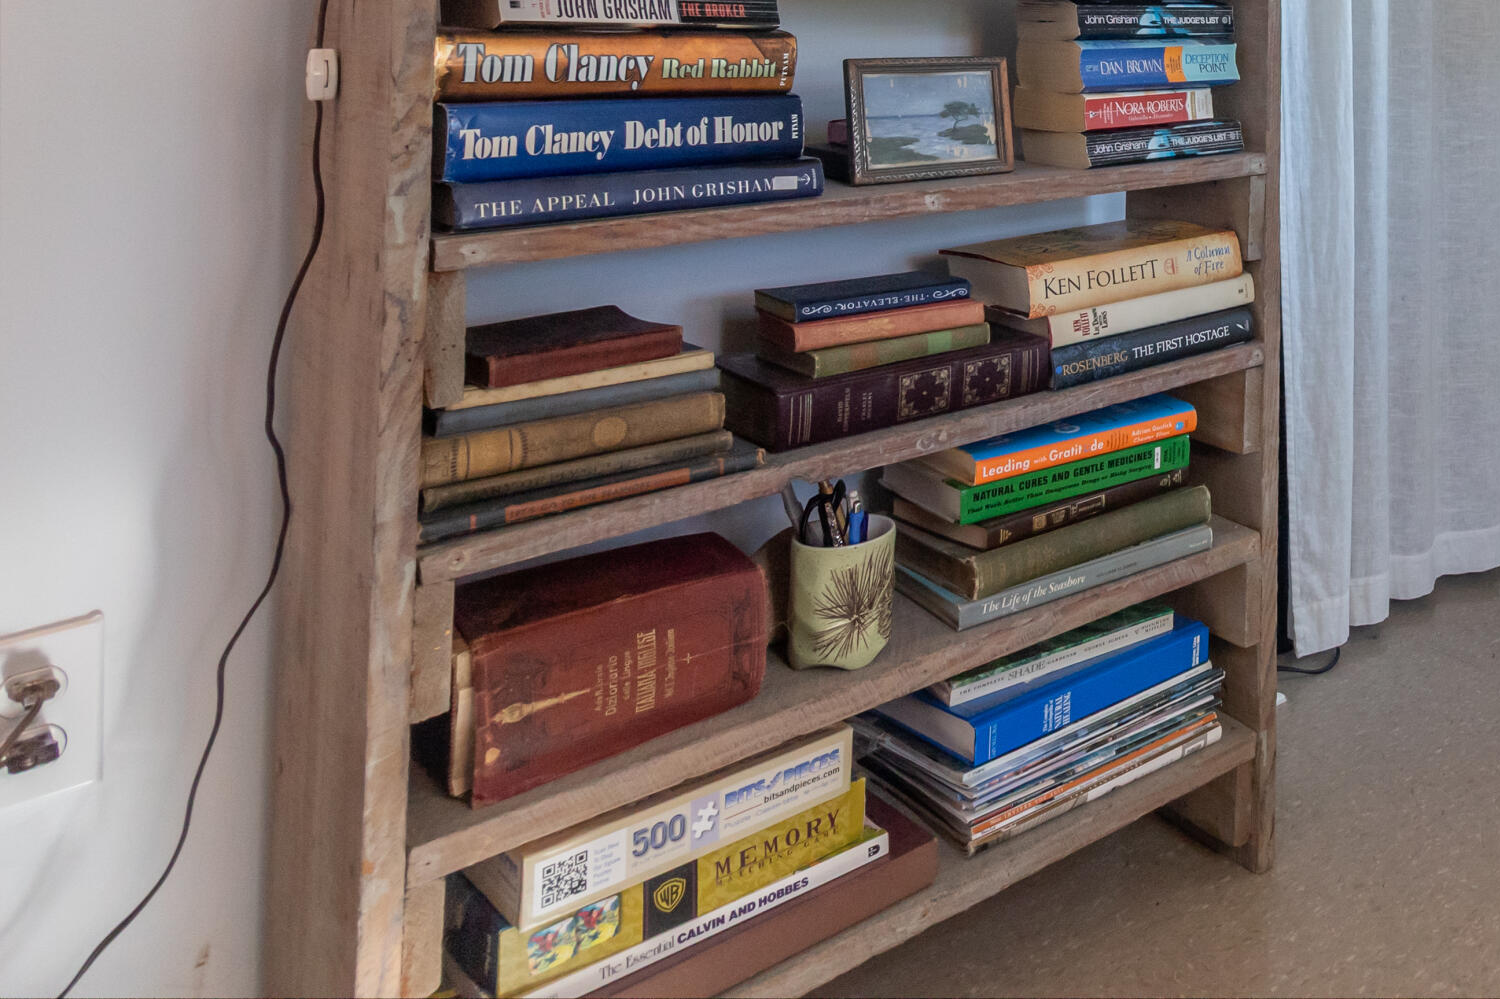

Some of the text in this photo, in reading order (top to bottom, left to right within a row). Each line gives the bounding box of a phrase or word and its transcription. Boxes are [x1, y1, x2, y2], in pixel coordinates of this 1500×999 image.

[682, 1, 746, 18] THE BROKER
[1085, 14, 1139, 25] John Grisham
[1163, 16, 1177, 24] THE
[1205, 16, 1219, 24] LIST
[457, 42, 655, 91] Tom Clancy
[662, 57, 777, 79] Red Rabbit
[780, 53, 789, 87] PUTNAM
[1100, 61, 1124, 76] DAN
[1127, 58, 1163, 75] BROWN
[1185, 53, 1229, 64] DECEPTION
[1199, 62, 1227, 73] POINT
[1116, 101, 1144, 116] NORA
[1147, 99, 1184, 113] ROBERTS
[459, 124, 614, 160] Tom Clancy
[624, 116, 784, 150] Debt of Honor
[1213, 134, 1227, 142] LIST
[1094, 141, 1147, 154] John Grisham
[632, 177, 775, 205] JOHN GRISHAM
[475, 191, 616, 219] THE APPEAL
[1186, 244, 1231, 262] A Column
[1044, 259, 1158, 299] KEN FOLLETT
[1194, 260, 1224, 277] of Fire
[840, 293, 926, 311] THE ELEVATOR
[1073, 318, 1081, 334] KEN
[1080, 312, 1090, 336] FOLLETT
[1132, 325, 1230, 359] THE FIRST HOSTAGE
[1062, 350, 1129, 376] ROSENBERG
[973, 484, 1015, 502] NATURAL
[1018, 475, 1048, 492] CURES
[1051, 470, 1070, 483] AND
[1073, 462, 1105, 478] GENTLE
[1107, 450, 1153, 469] MEDICINES
[982, 459, 1030, 479] Leading
[982, 575, 1087, 615] The Life of the Seashore
[1006, 660, 1047, 681] SHADE
[605, 655, 618, 717] Dizionario
[1054, 695, 1063, 730] NATURAL
[1062, 690, 1072, 726] HEALING
[725, 778, 767, 809] BITS
[783, 748, 840, 786] PIECES
[763, 766, 840, 804] bitsandpieces.com
[632, 813, 686, 858] 500
[714, 809, 840, 880] MEMORY
[599, 877, 809, 981] The Essential CALVIN AND HOBBES
